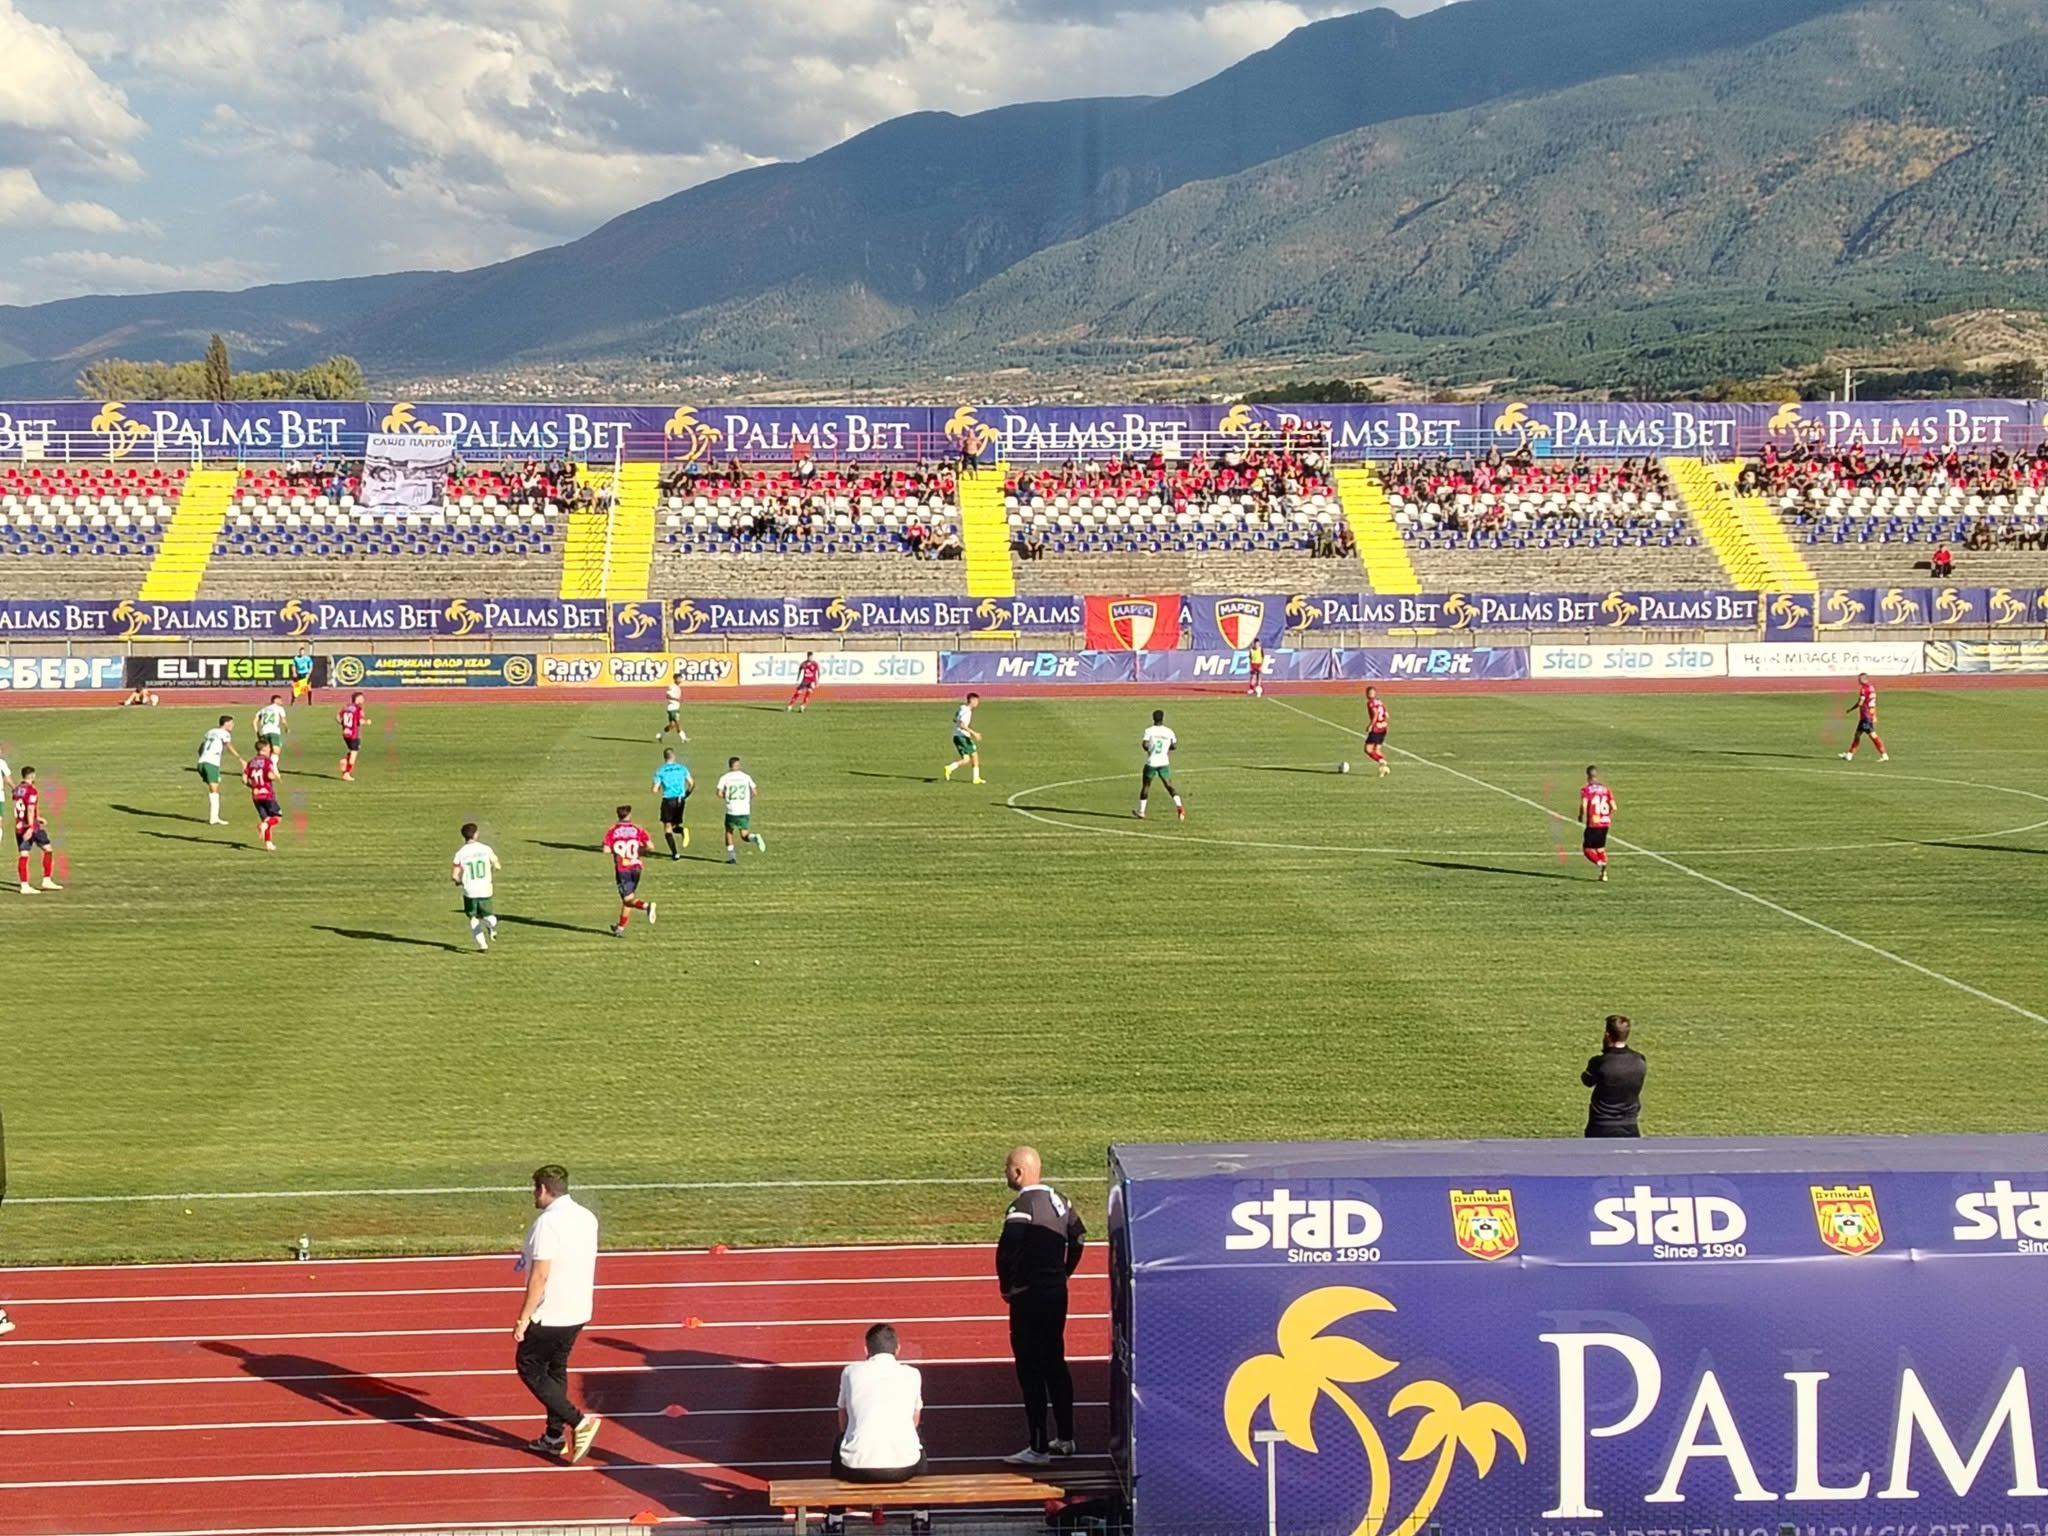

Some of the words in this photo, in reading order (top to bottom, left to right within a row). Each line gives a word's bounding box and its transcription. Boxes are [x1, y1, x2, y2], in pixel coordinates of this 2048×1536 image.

[152, 411, 272, 448] PALMS
[278, 411, 346, 448] BET
[442, 413, 559, 448] PALMS
[566, 414, 632, 451] BET
[724, 415, 838, 452] PALMS
[845, 415, 911, 452] BET
[1003, 414, 1116, 450] PALMS
[1122, 414, 1187, 450] BET
[1397, 413, 1461, 448] BET
[1553, 412, 1665, 447] PALMS
[1672, 412, 1735, 449] BET
[1827, 411, 1938, 447] PALMS
[1945, 409, 2009, 446] BET
[64, 605, 109, 630] BET
[152, 606, 229, 631] PALMS
[233, 605, 276, 630] BET
[319, 605, 395, 630] PALMS
[400, 605, 442, 629] BET
[484, 604, 558, 629] PALMS
[563, 604, 606, 629] BET
[710, 604, 779, 628] PALMS
[784, 604, 823, 627] BET
[861, 603, 930, 627] PALMS
[934, 603, 974, 626] BET
[1012, 602, 1080, 626] PALMS
[1219, 602, 1259, 616] МАРЕК
[1323, 600, 1394, 624] PALMS
[1399, 600, 1440, 624] BET
[1481, 599, 1552, 624] PALMS
[1557, 598, 1598, 623] BET
[1640, 597, 1712, 621] PALMS
[1716, 597, 1758, 621] BET
[157, 659, 294, 679] ELITBET
[544, 658, 602, 680] Party
[610, 658, 668, 679] Party
[674, 657, 732, 679] Party
[997, 652, 1079, 677] MrBit
[1193, 653, 1275, 677] MrBt
[1390, 650, 1474, 675] MrBit
[728, 784, 747, 801] 23
[1591, 794, 1610, 815] 16
[613, 839, 640, 859] 90
[466, 860, 486, 880] 10
[1453, 1195, 1509, 1204] ДУПНИЦА
[1815, 1191, 1869, 1200] ДУПНИЦА
[1287, 1248, 1332, 1263] Since
[1336, 1247, 1380, 1262] 1990
[1653, 1244, 1698, 1259] Since
[1702, 1243, 1747, 1258] 1990
